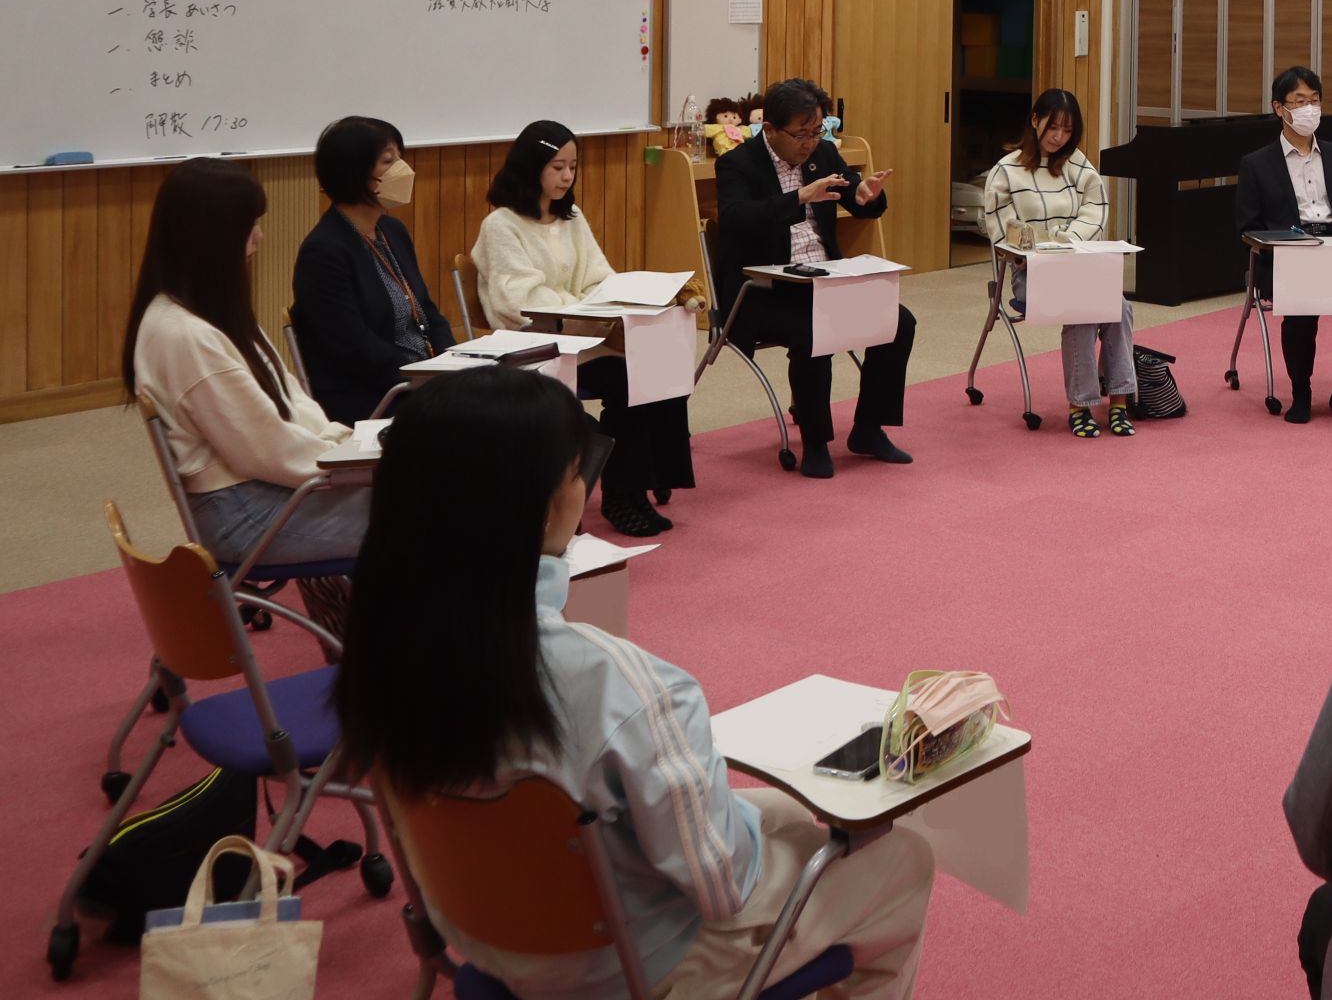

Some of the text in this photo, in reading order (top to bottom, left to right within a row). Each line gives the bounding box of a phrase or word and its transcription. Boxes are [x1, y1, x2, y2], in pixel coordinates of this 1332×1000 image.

[149, 70, 192, 88] まとめ
[201, 114, 248, 132] 17:30
